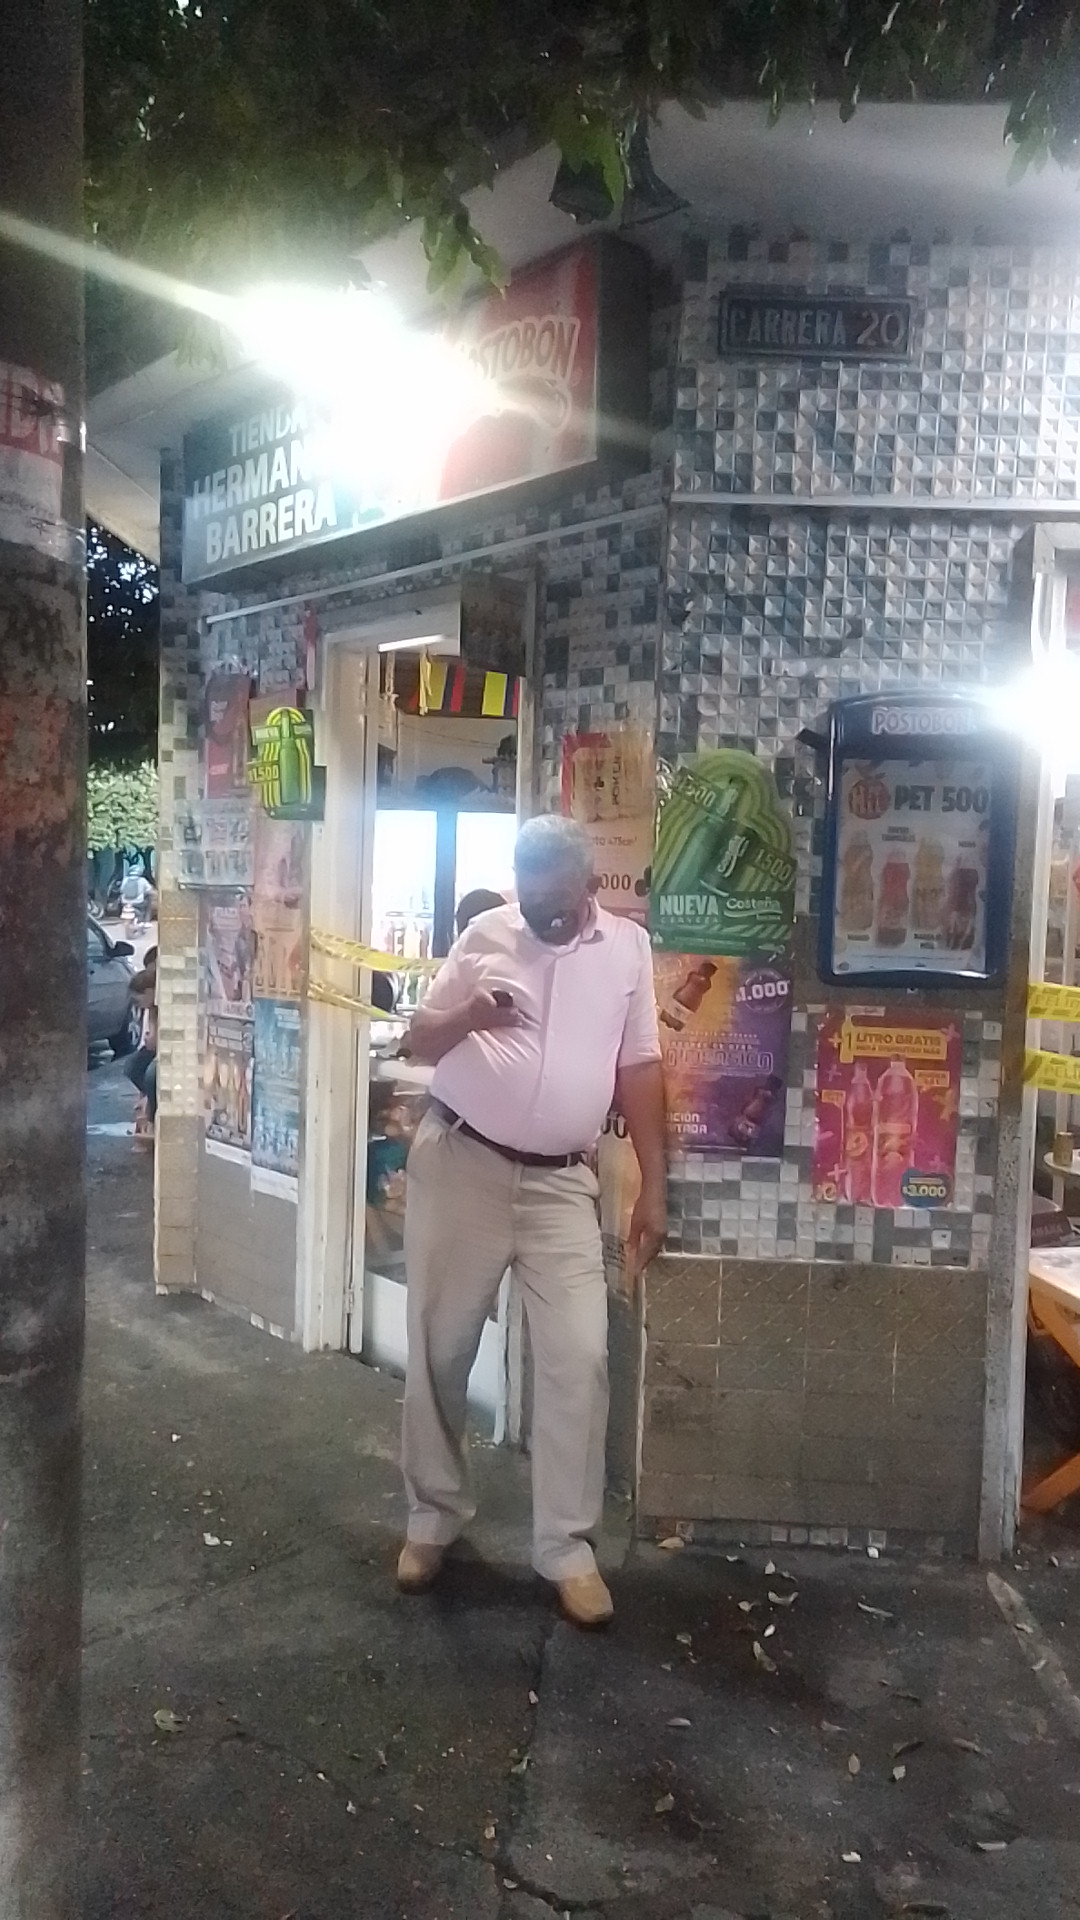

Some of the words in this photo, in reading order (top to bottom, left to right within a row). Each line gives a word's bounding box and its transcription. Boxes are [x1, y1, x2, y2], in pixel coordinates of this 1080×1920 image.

[729, 309, 846, 345] CARRERA
[856, 311, 905, 347] 20
[229, 402, 309, 457] TIENDA
[206, 481, 338, 564] BARRERA
[894, 785, 935, 811] PET
[942, 786, 989, 813] 500
[754, 848, 792, 881] 1500
[659, 895, 719, 916] NUEVA
[856, 1032, 892, 1044] LITRO
[895, 1034, 941, 1046] GRATIS
